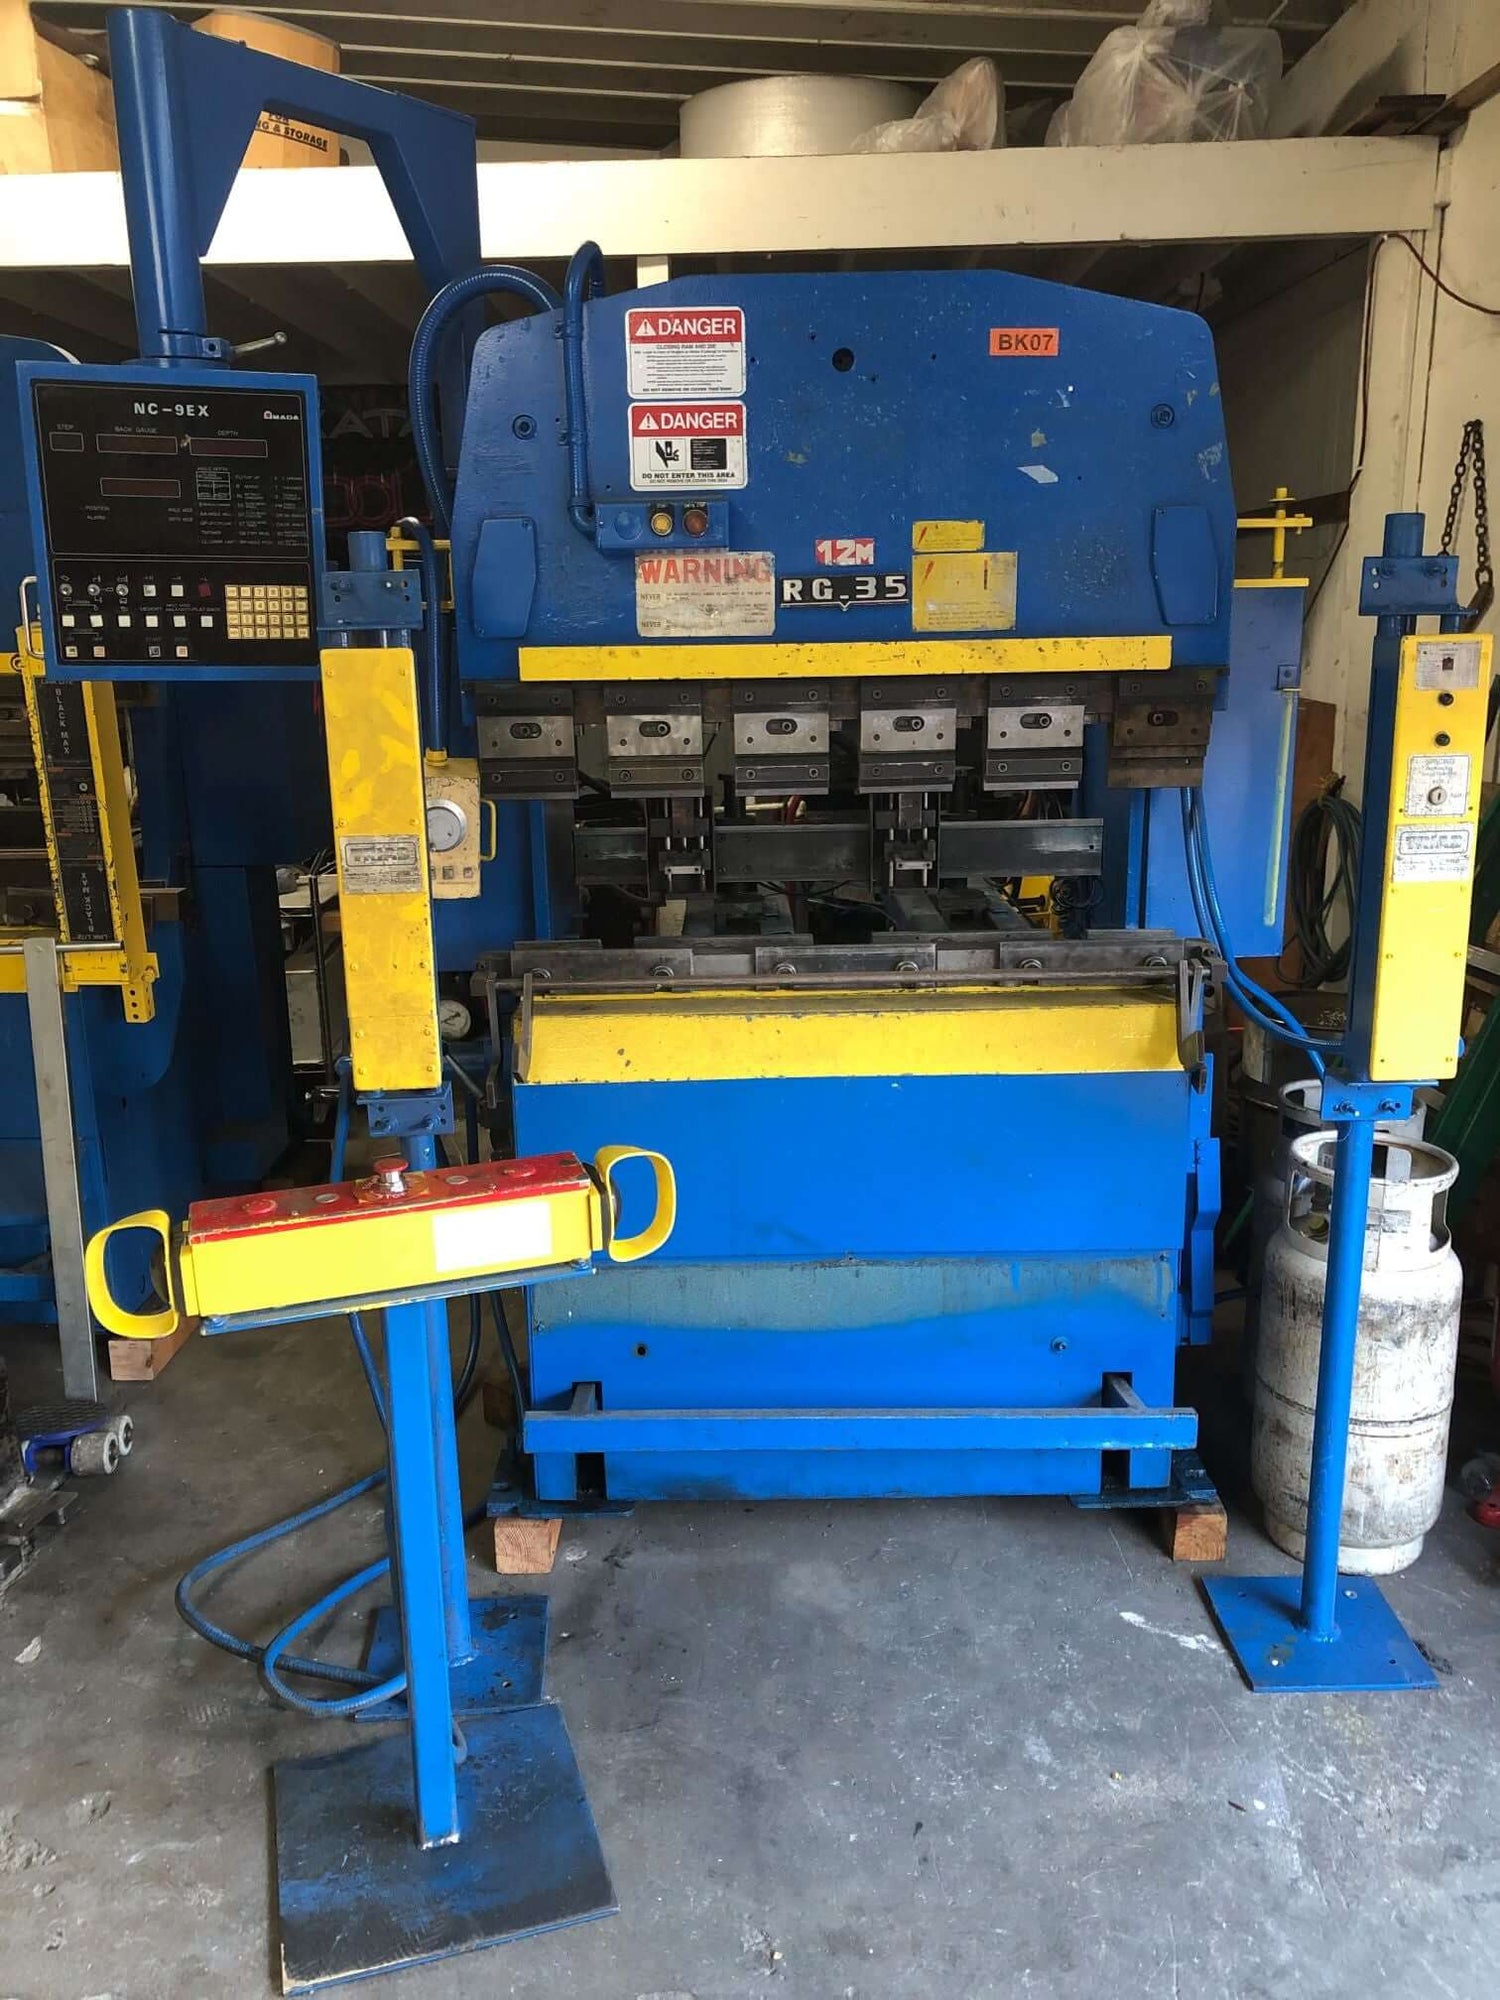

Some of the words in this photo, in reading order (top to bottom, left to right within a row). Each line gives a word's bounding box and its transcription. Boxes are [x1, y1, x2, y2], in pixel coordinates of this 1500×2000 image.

[284, 127, 329, 148] STORAGE
[658, 318, 736, 336] DANGER
[998, 334, 1054, 351] BK07
[134, 402, 210, 417] NC-9EX
[660, 412, 738, 430] DANGER
[640, 558, 772, 584] WARNING
[641, 593, 661, 601] NEVER
[56, 688, 67, 727] BLACK
[61, 732, 70, 754] MAX
